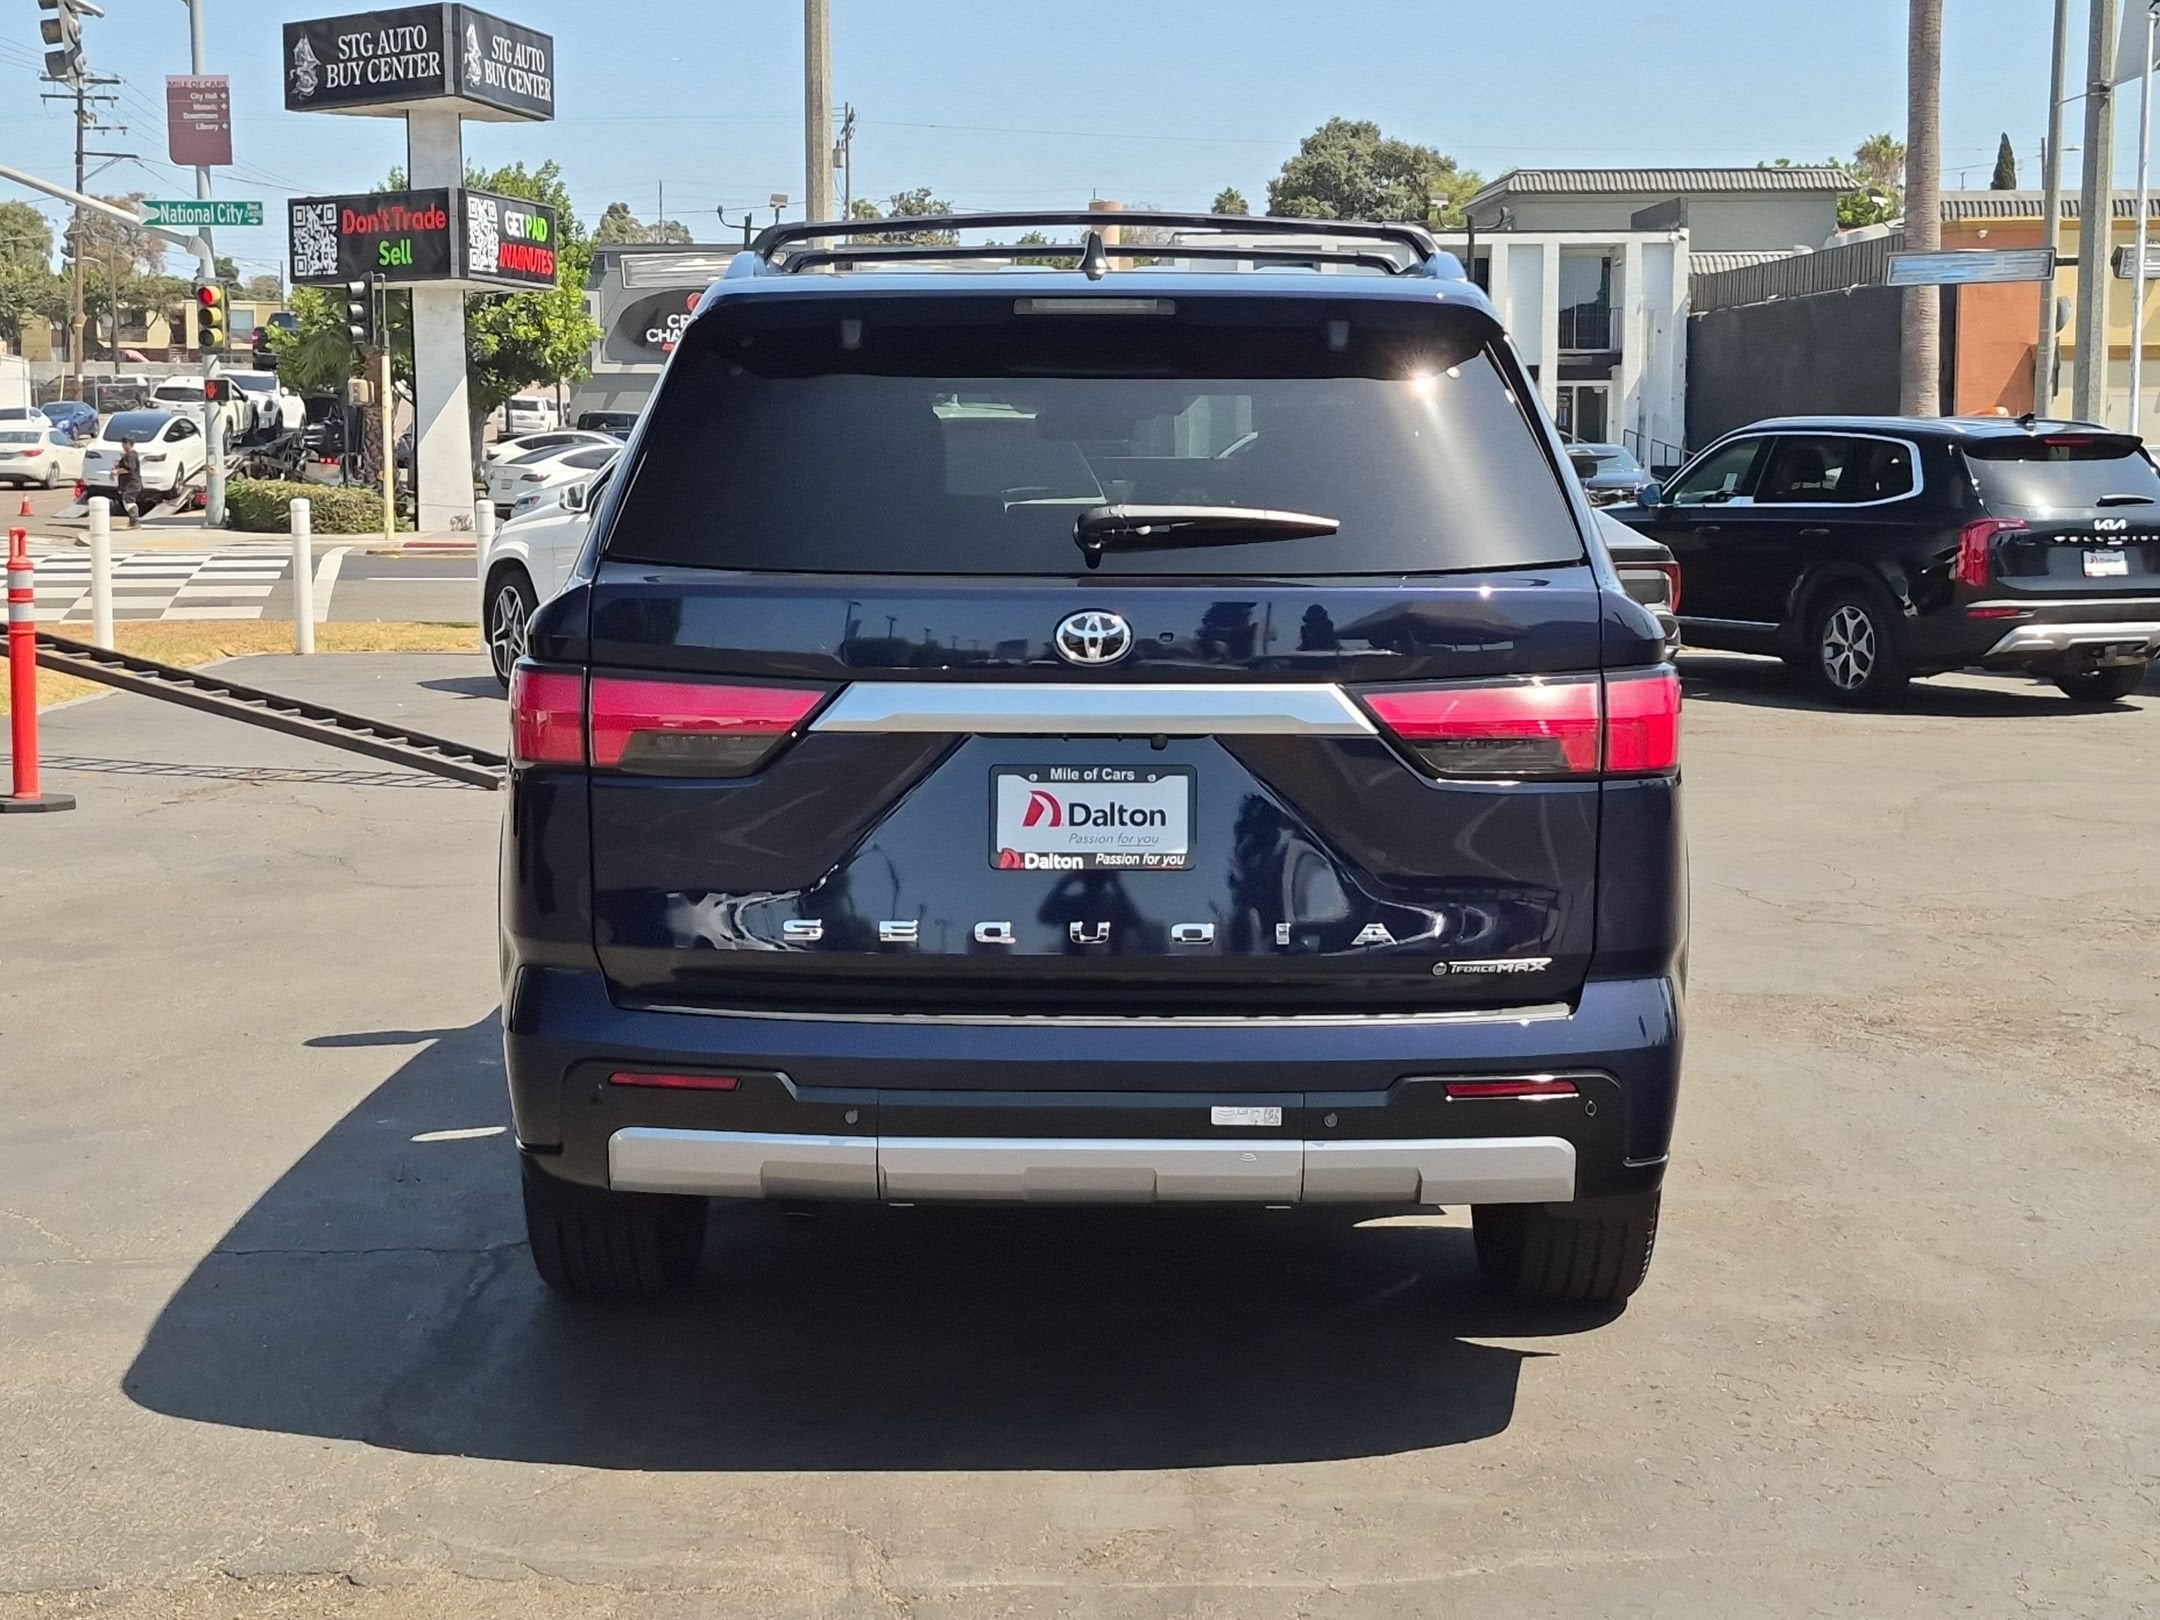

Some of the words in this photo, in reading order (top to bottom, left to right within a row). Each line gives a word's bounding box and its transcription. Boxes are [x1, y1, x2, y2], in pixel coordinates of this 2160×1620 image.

[338, 33, 373, 60] STG
[377, 25, 427, 54] AUTO
[491, 35, 513, 62] STG
[514, 43, 545, 73] AUTO
[326, 61, 365, 89] BUY
[367, 51, 441, 83] CENTER
[484, 59, 509, 87] BUY
[508, 65, 551, 102] CENTER
[160, 203, 214, 224] National
[217, 203, 244, 225] City
[341, 208, 390, 235] Don't
[391, 203, 446, 231] Trade
[505, 210, 524, 238] GET
[525, 214, 548, 243] PAID
[378, 238, 413, 266] Sell
[511, 244, 554, 275] MINUTES
[1050, 768, 1079, 781] Mile
[1083, 767, 1099, 781] of
[1102, 768, 1135, 781] Cars
[1068, 802, 1166, 827] Dalton
[1068, 833, 1113, 845] Passion
[1117, 833, 1134, 845] for
[1137, 834, 1159, 846] you
[1024, 853, 1084, 870] Dalton
[1095, 853, 1140, 866] Passion
[1143, 853, 1161, 865] for
[1161, 854, 1185, 867] you
[783, 918, 1398, 945] SEQUOIA
